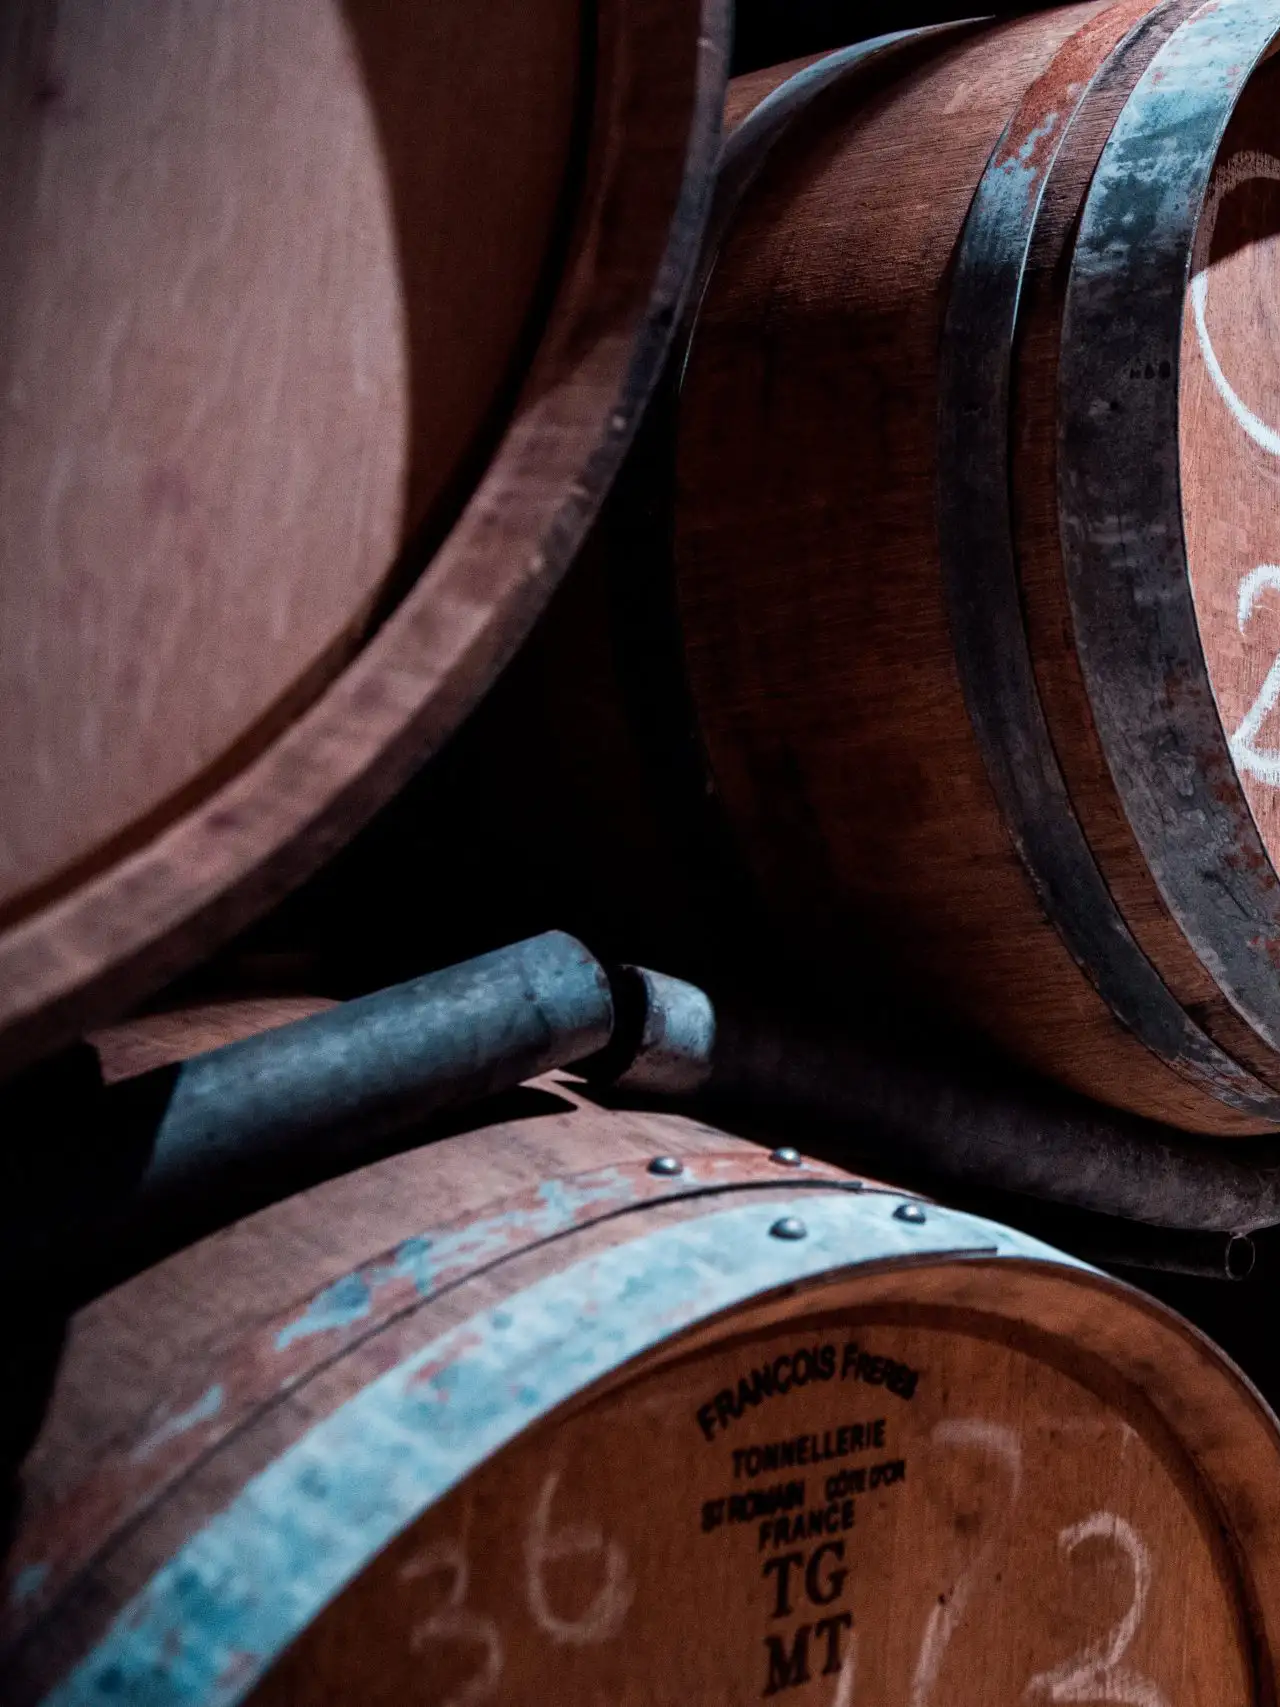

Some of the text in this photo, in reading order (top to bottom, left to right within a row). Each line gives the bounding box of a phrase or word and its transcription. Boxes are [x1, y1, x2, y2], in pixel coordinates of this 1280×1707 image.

[732, 1418, 887, 1478] TONNELLERIE
[758, 1500, 855, 1553] FRANCE
[762, 1540, 849, 1620] TG
[761, 1610, 854, 1699] MT
